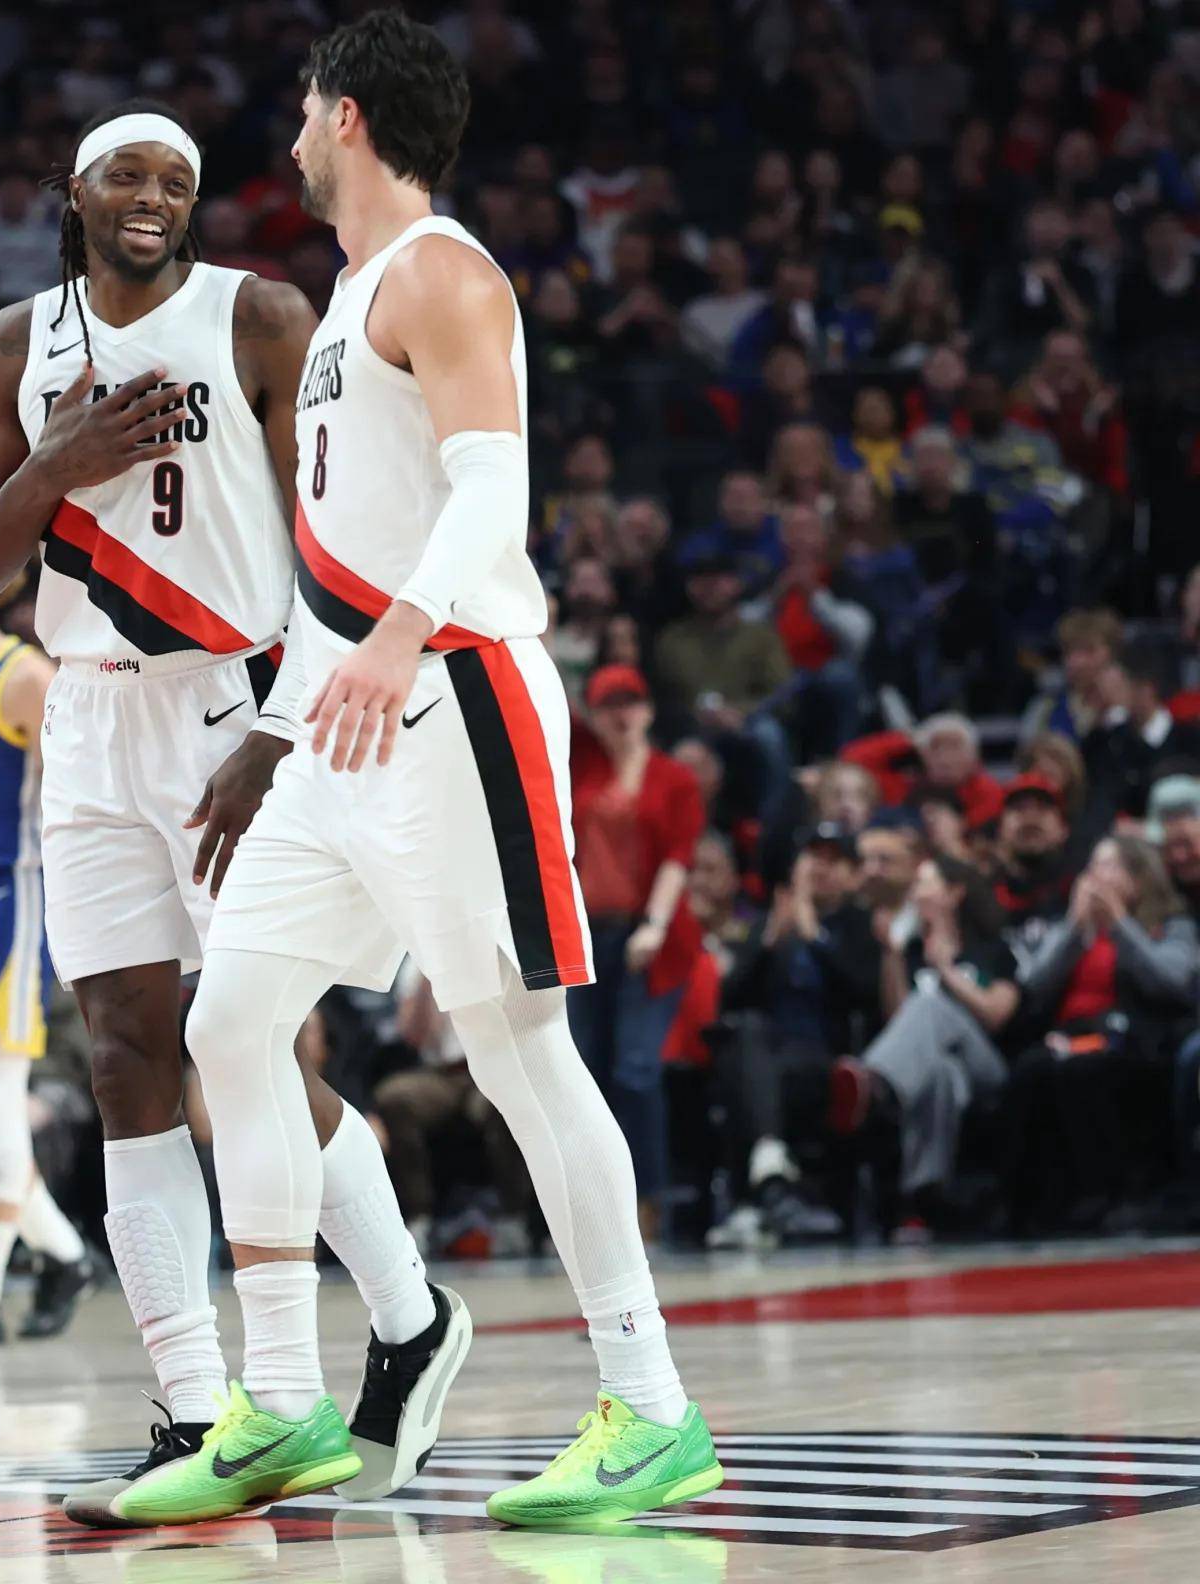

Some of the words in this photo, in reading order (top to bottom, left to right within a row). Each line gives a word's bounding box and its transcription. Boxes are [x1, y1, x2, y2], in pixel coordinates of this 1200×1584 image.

[296, 338, 345, 412] AZERS
[152, 461, 184, 537] 9
[312, 423, 327, 500] 8
